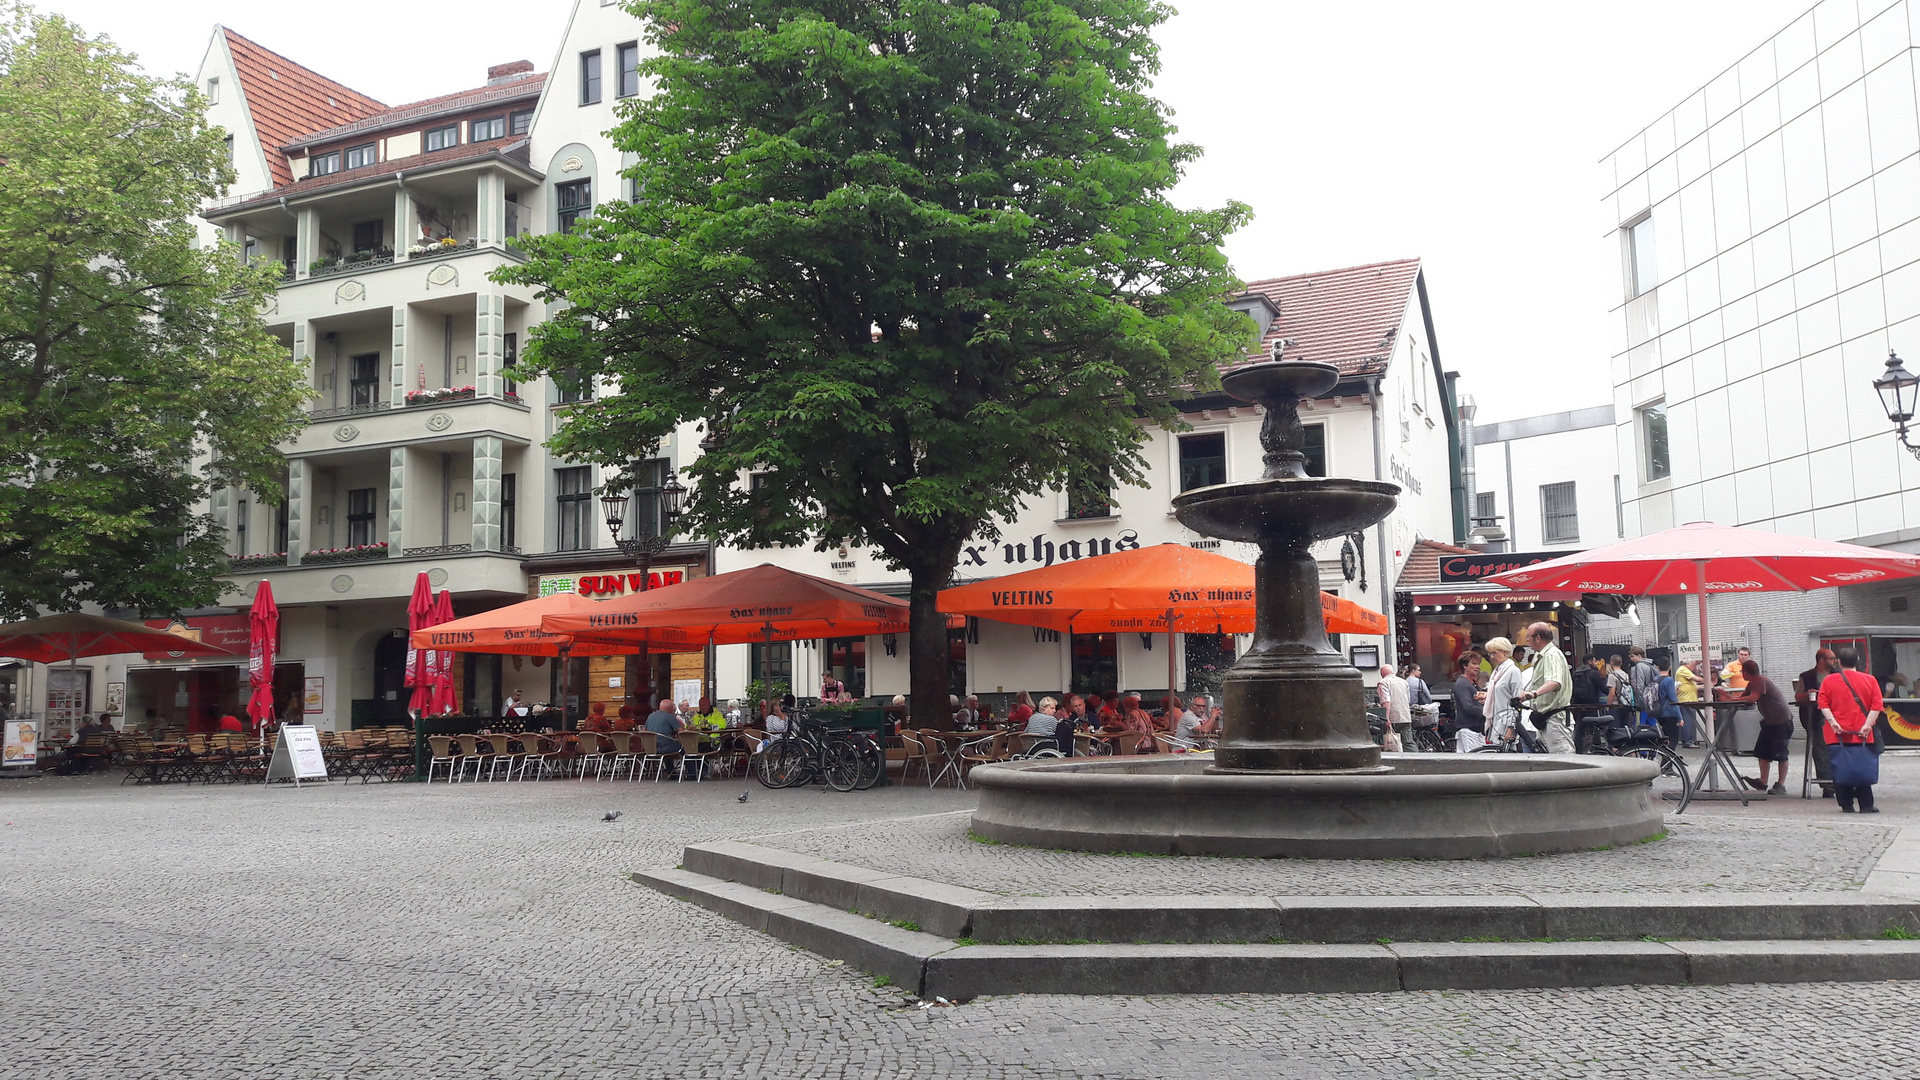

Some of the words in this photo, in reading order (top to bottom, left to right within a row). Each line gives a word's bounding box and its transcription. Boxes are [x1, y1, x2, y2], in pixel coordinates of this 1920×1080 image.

[955, 529, 1140, 567] x'nhaus
[1190, 540, 1221, 549] VELTINS
[831, 561, 856, 569] VELTINS
[579, 574, 625, 595] SUN
[627, 571, 683, 592] WAH
[992, 590, 1053, 606] VELTINS
[1454, 595, 1489, 603] Berliner
[1493, 594, 1540, 602] Currywurst
[862, 605, 887, 618] VELTINS
[589, 612, 638, 627] VELTINS
[432, 631, 475, 645] VELTINS
